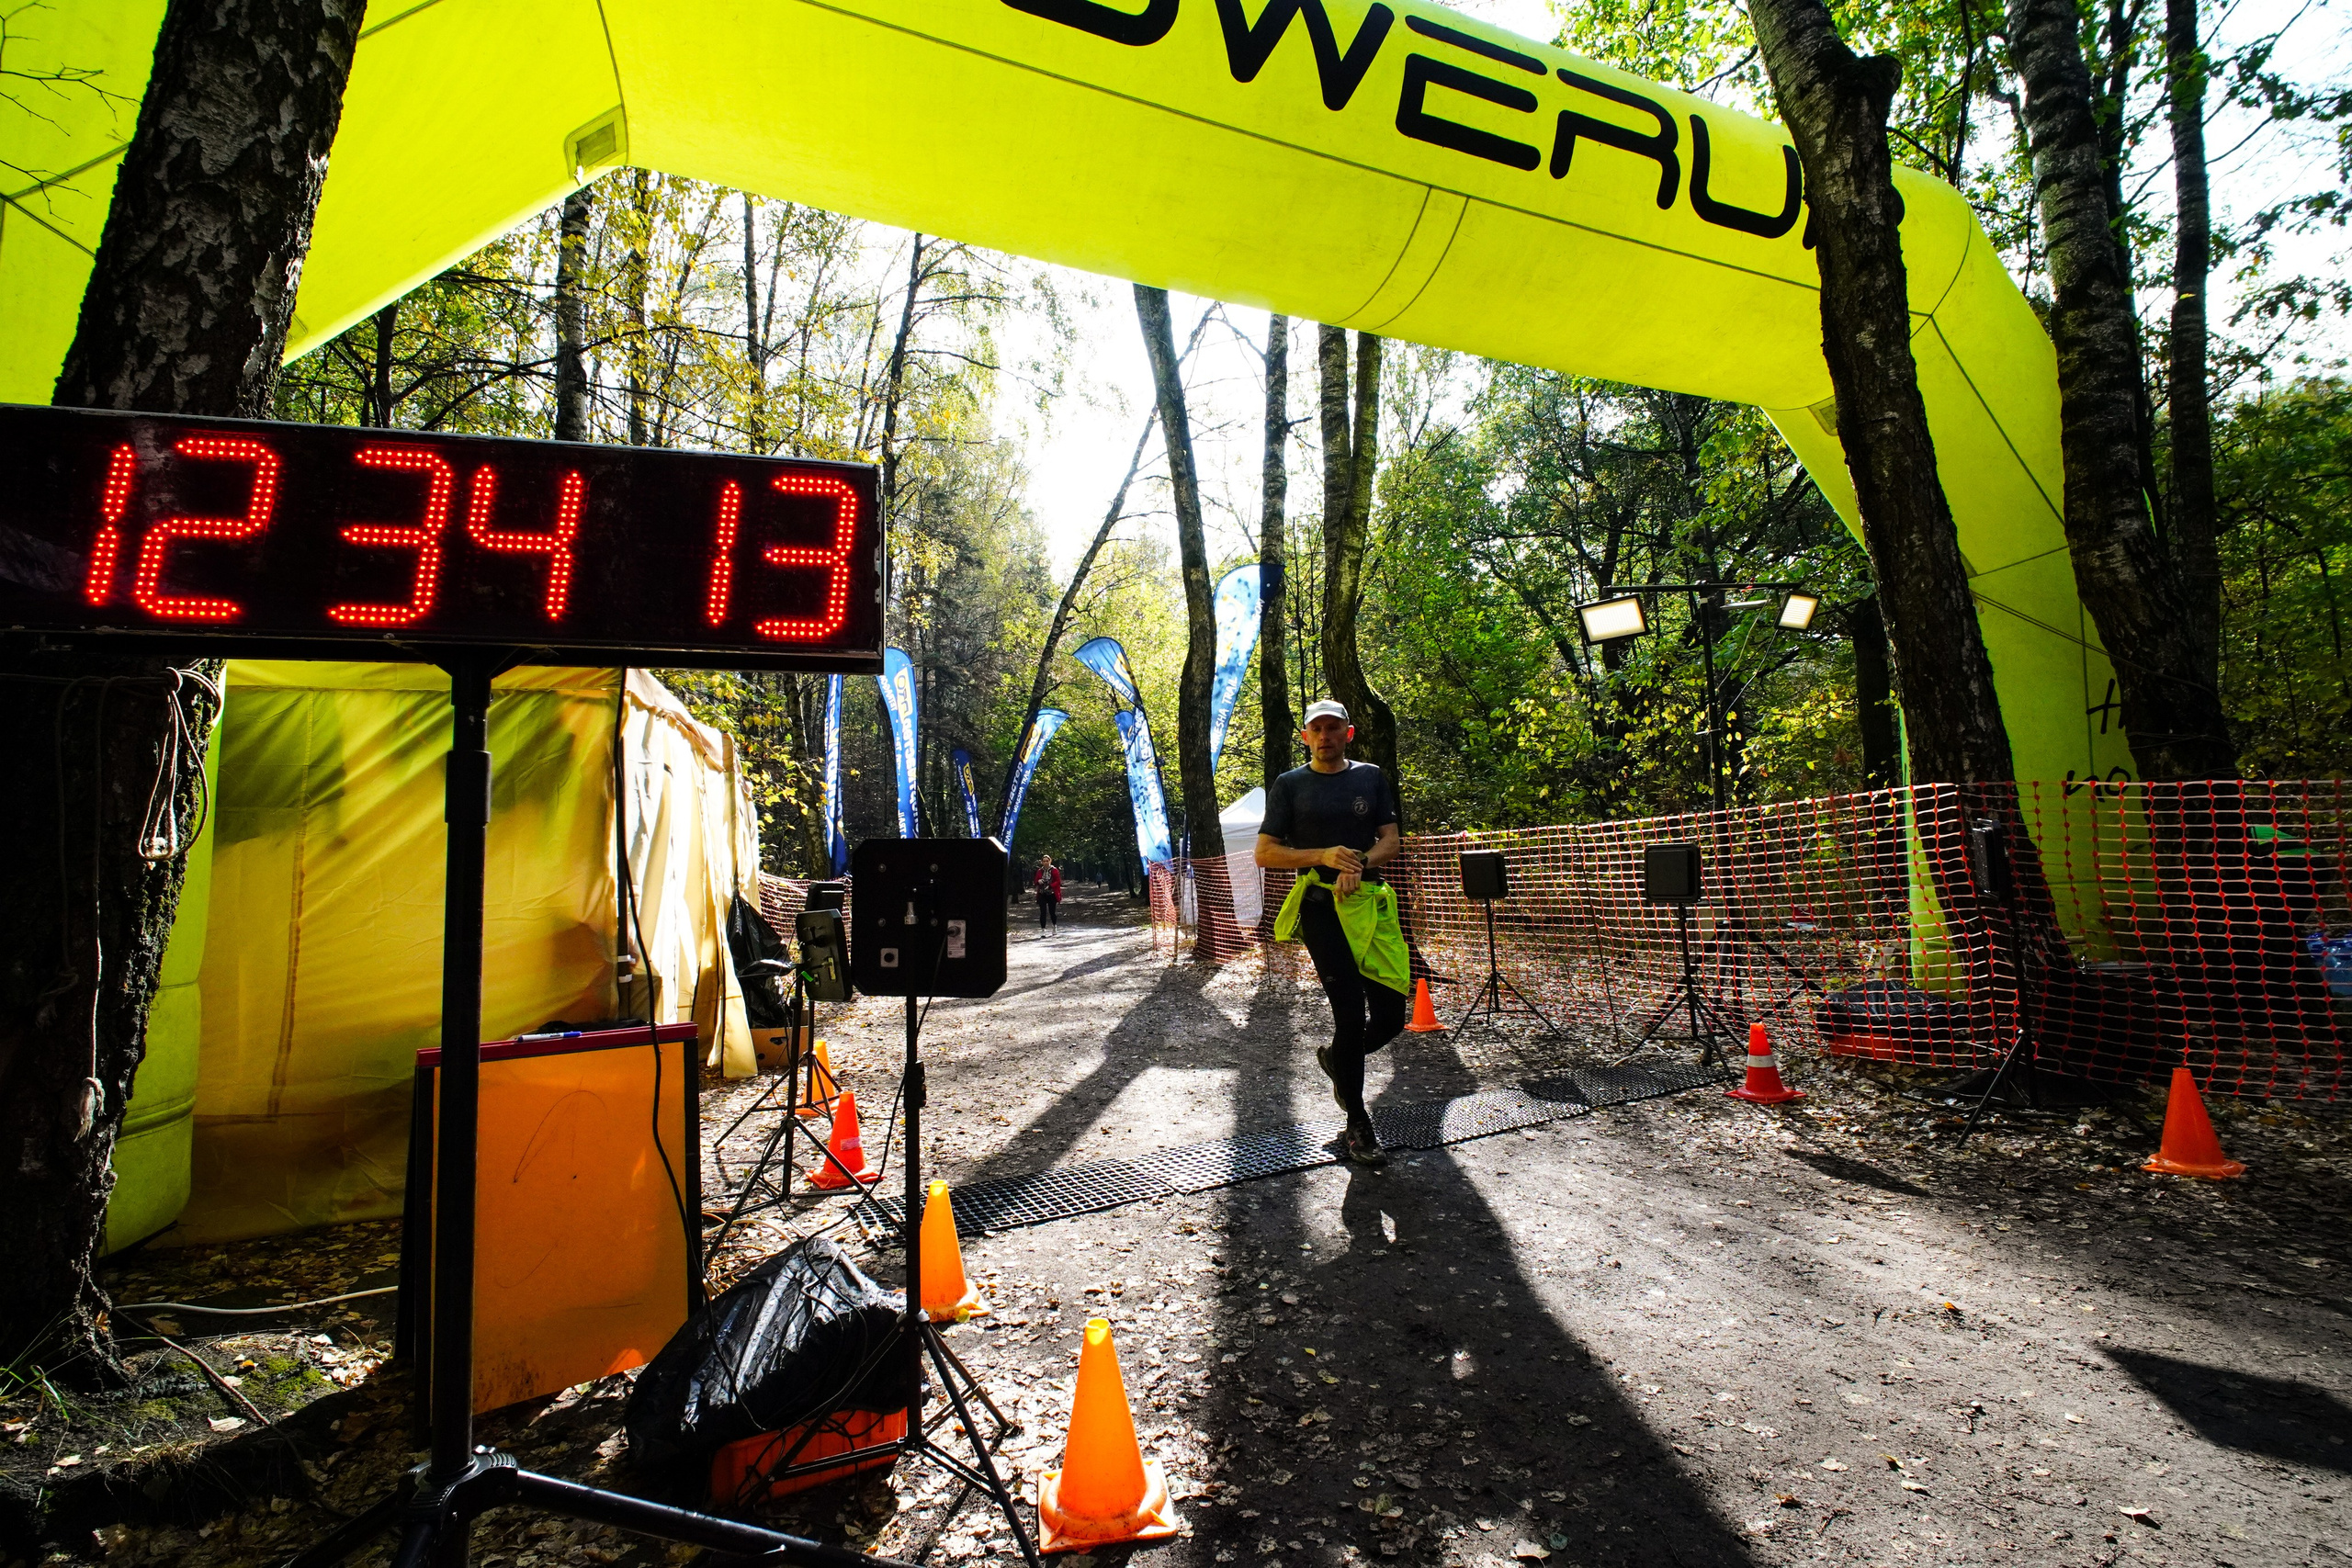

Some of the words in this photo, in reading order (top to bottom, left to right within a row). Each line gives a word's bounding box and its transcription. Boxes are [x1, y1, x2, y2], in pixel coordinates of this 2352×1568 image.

[85, 437, 278, 620] 12
[328, 448, 582, 626] 34
[707, 474, 859, 641] 13
[1222, 677, 1238, 705] TRAIL
[1022, 769, 1031, 785] TRAIL
[1003, 829, 1012, 848] TRAIL
